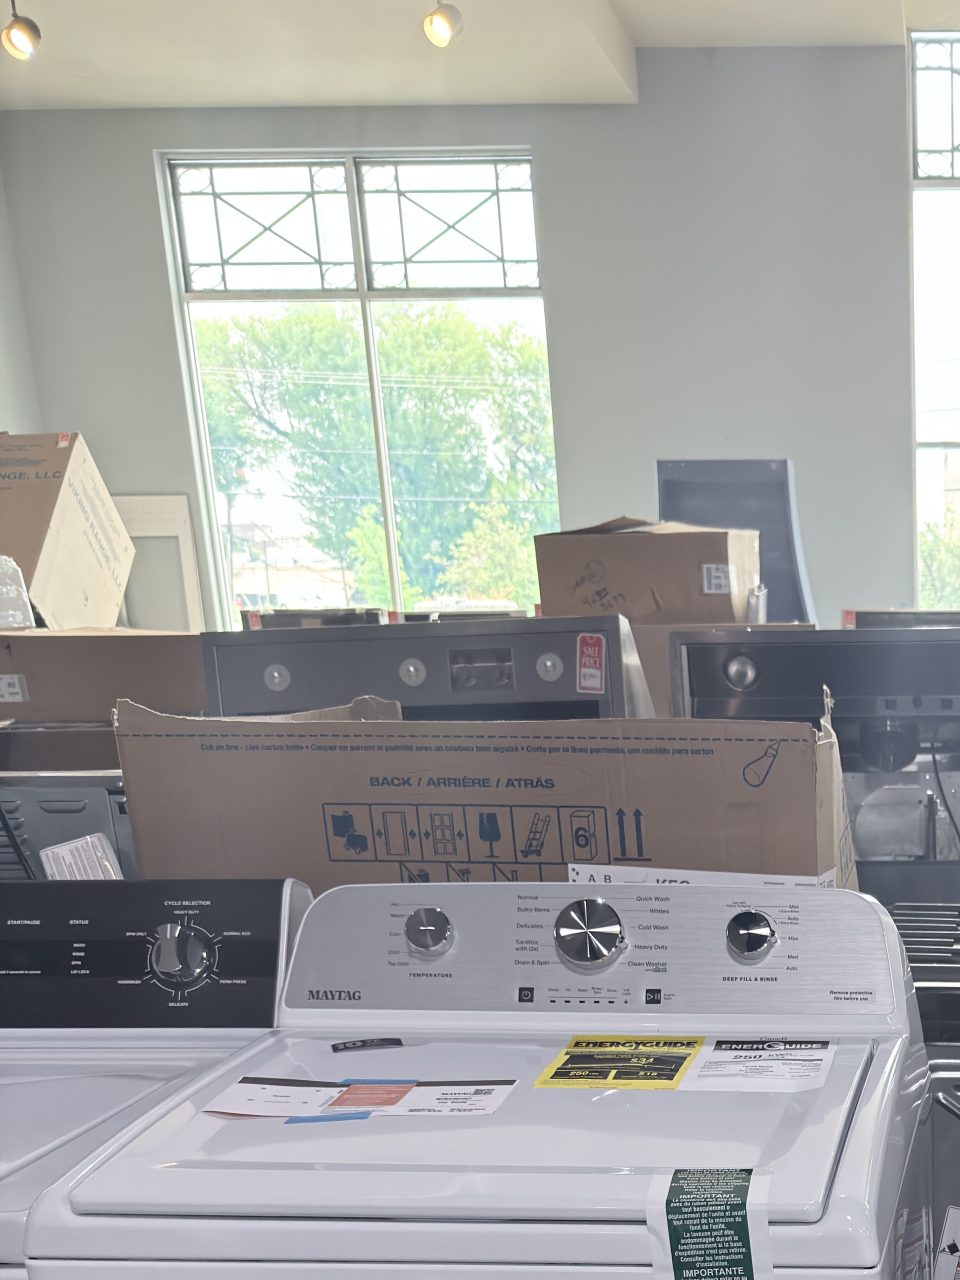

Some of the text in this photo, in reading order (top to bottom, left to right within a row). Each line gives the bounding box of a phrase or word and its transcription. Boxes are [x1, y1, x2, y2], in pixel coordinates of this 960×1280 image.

[35, 470, 62, 480] LLC
[583, 646, 599, 656] SALE
[582, 656, 600, 667] PRICE
[369, 776, 412, 787] BACK
[505, 774, 555, 789] ATRÁS
[574, 826, 590, 849] 6
[588, 874, 612, 884] A B
[307, 989, 362, 1001] MAYTAG
[849, 989, 873, 997] protective
[573, 1040, 698, 1050] ENERGYGUIDE
[721, 1040, 823, 1051] ENERGUIDE
[682, 1267, 745, 1277] IMPORTANTE
